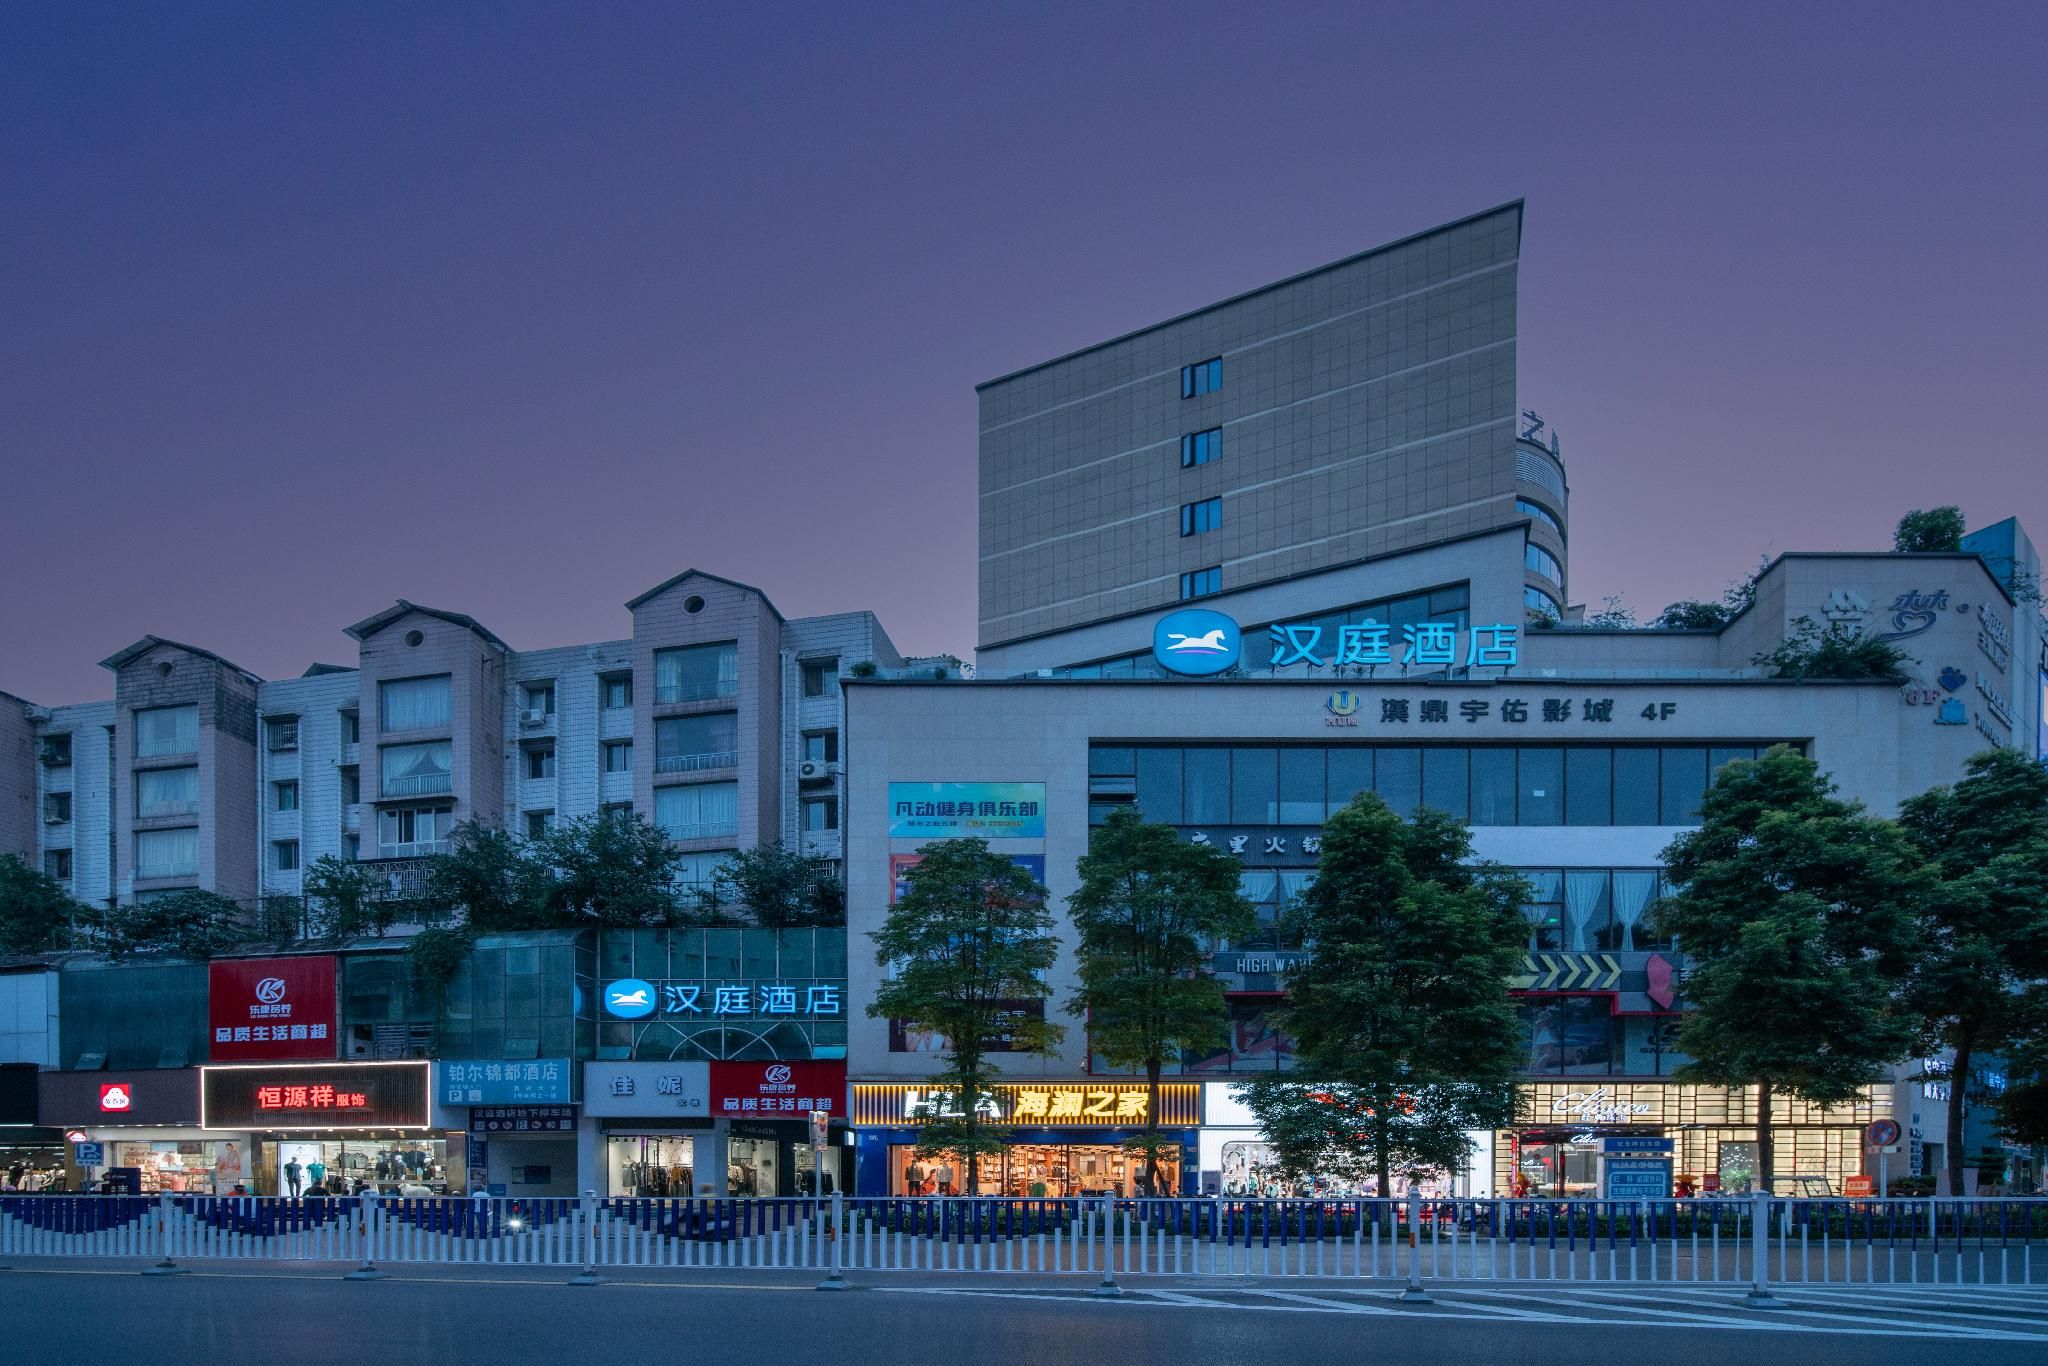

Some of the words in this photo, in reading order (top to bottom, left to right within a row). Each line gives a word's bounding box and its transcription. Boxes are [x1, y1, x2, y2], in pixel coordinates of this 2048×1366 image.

[1270, 622, 1519, 667] 汉庭酒店
[1381, 698, 1619, 723] 漢鼎宇佑影城
[1641, 702, 1676, 720] 4F
[895, 801, 1038, 817] 凡动健身俱乐部
[1236, 958, 1270, 973] HIGH
[665, 984, 839, 1014] 汉庭酒店
[216, 1023, 328, 1043] 品质生活商超
[448, 1062, 559, 1082] 铂尔锦都酒店
[258, 1085, 335, 1109] 恒源祥
[336, 1093, 366, 1108] 服饰
[723, 1097, 833, 1111] 品质生活商超
[1013, 1090, 1148, 1117] 海澜之家
